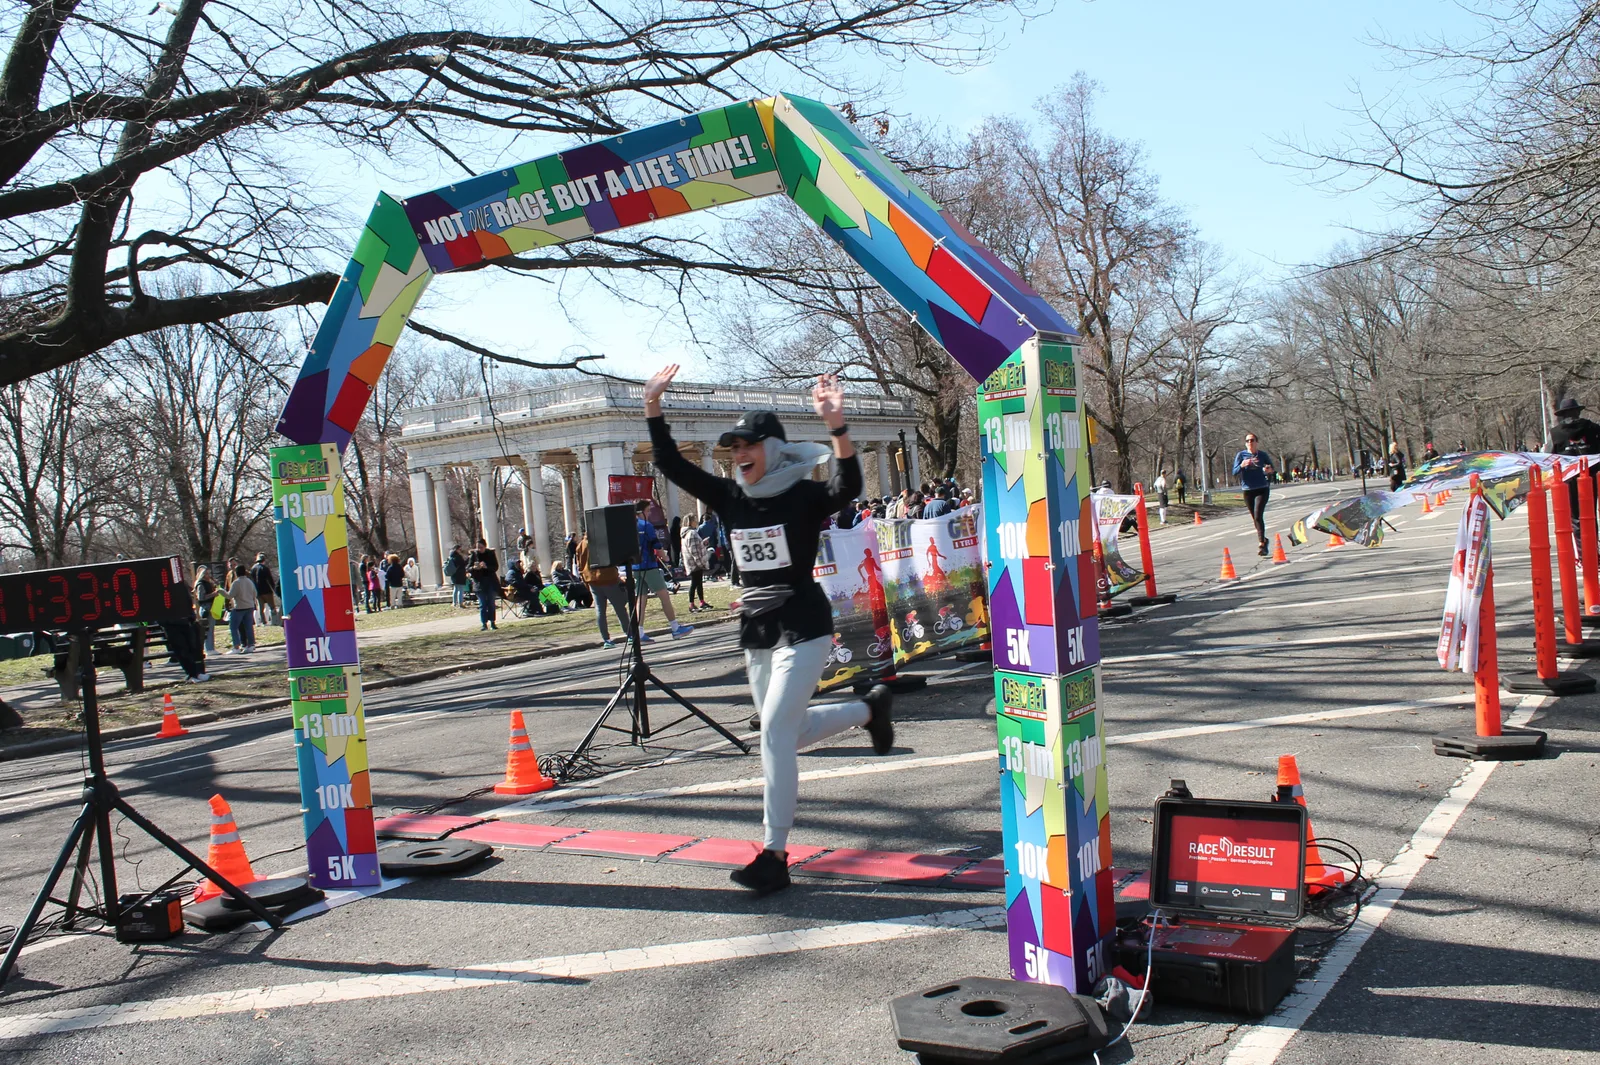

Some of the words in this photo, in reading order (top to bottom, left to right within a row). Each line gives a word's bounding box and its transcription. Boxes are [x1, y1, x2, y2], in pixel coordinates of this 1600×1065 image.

[423, 212, 469, 246] NOT
[468, 204, 493, 233] ONE
[490, 188, 555, 228] RACE
[550, 174, 603, 212] BUT
[603, 169, 629, 199] A
[623, 154, 681, 192] LIFE
[675, 134, 758, 179] TIME!
[983, 415, 1032, 454] 13.1m
[1046, 412, 1081, 450] 13.1m
[280, 492, 335, 518] 13.1m
[741, 542, 777, 563] 383
[996, 522, 1030, 559] 10K
[1058, 519, 1082, 558] 10K
[293, 564, 331, 591] 10K
[817, 566, 835, 576] DID
[305, 636, 333, 663] 5K
[1006, 628, 1032, 667] 5K
[1067, 625, 1085, 665] 5K
[299, 712, 358, 739] 13.1m
[1002, 735, 1055, 780] 13.1m
[1066, 735, 1102, 780] 13.1m
[315, 783, 355, 810] 10K
[327, 855, 357, 881] 5K
[1015, 839, 1051, 883] 10K
[1076, 835, 1102, 882] 10K
[1189, 842, 1218, 855] RACE
[1233, 845, 1276, 859] RESULT
[1024, 941, 1051, 984] 5K
[1086, 939, 1105, 984] 5K
